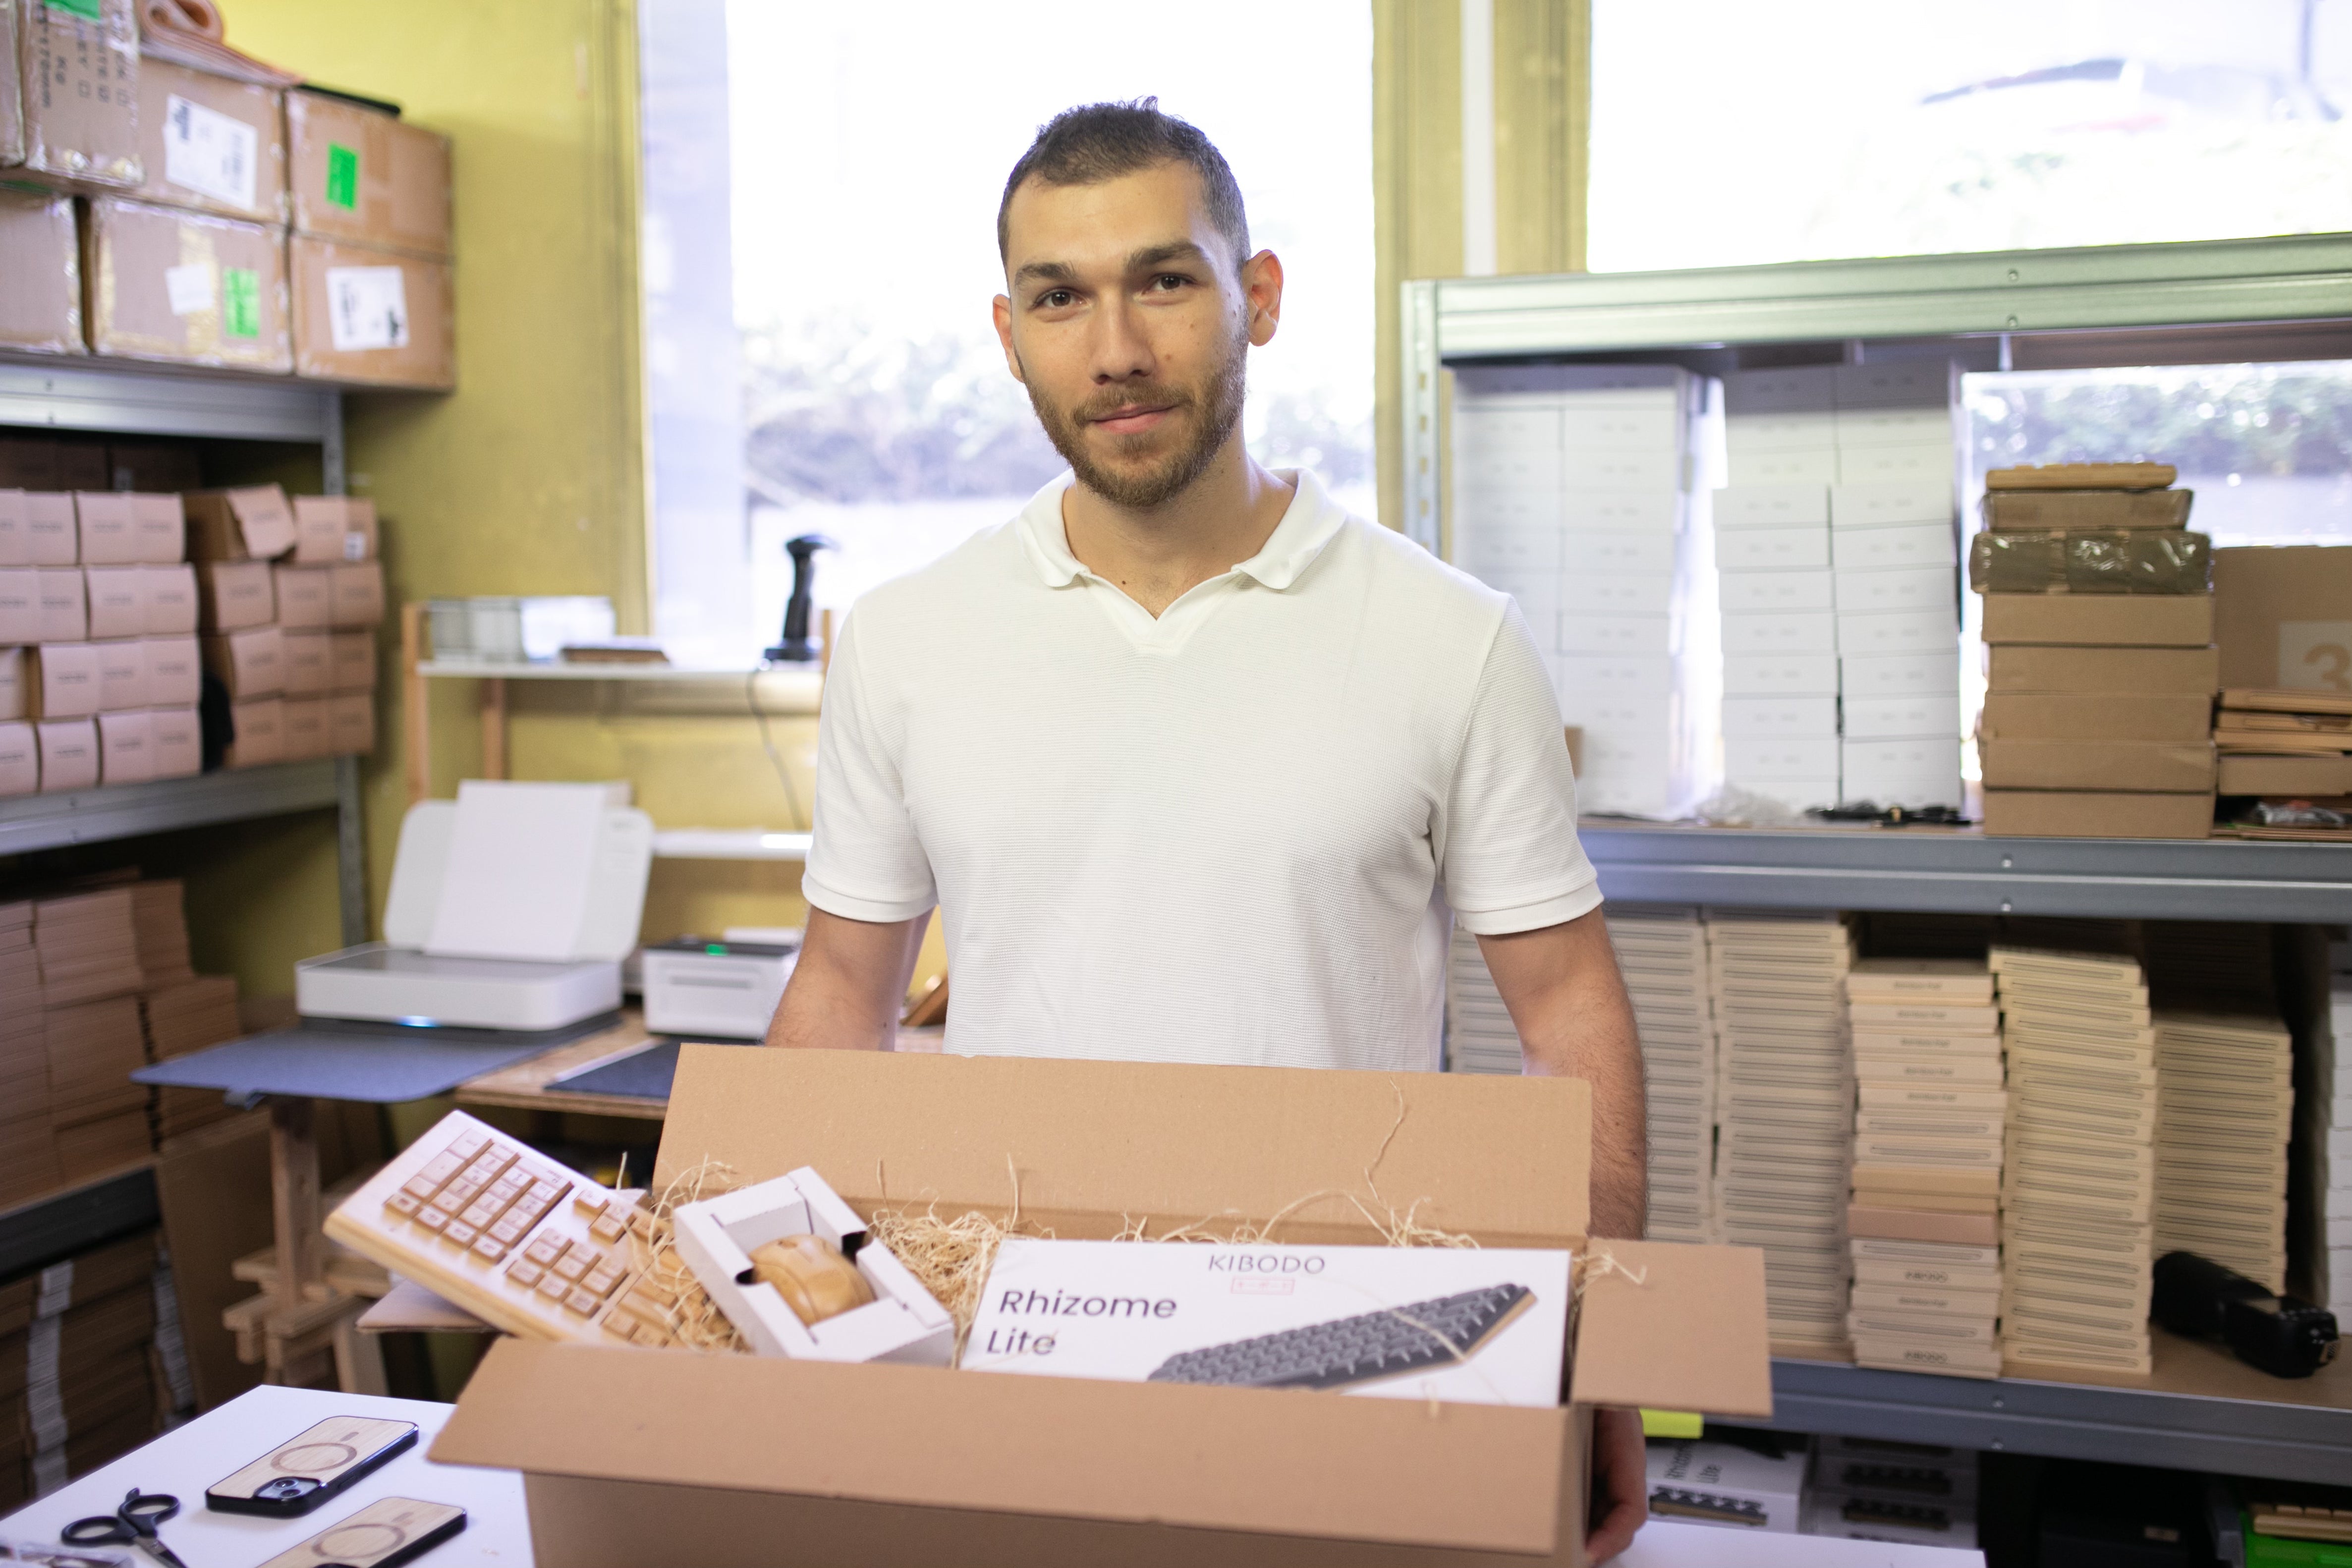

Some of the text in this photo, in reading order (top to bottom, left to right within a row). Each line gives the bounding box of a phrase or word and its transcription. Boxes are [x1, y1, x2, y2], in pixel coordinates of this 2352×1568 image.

[1208, 1254, 1326, 1275] KIBODO
[999, 1288, 1177, 1319] Rhizome
[986, 1326, 1057, 1355] Lite
